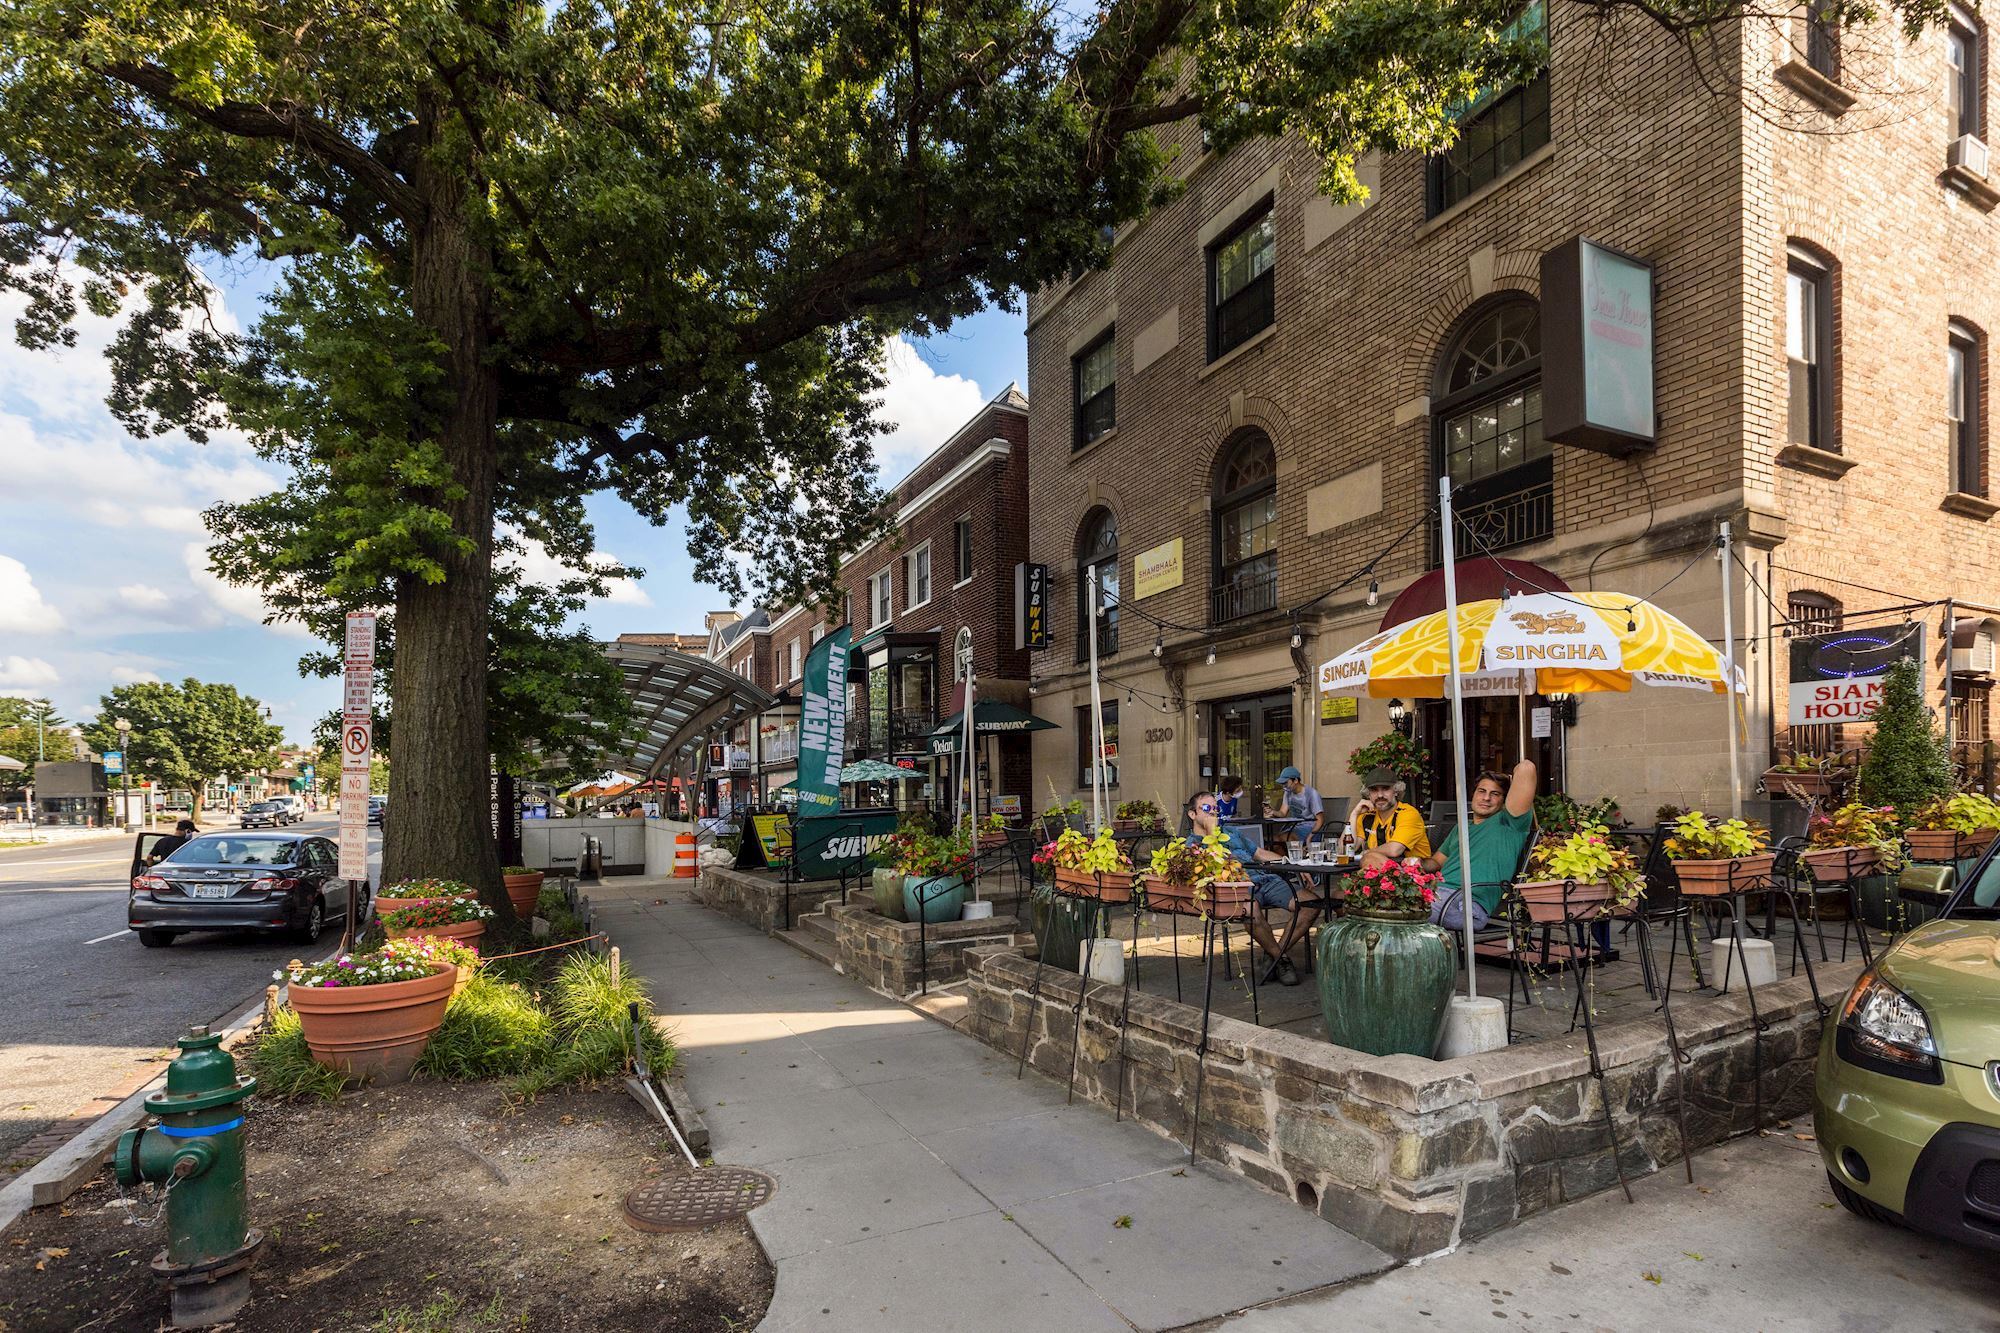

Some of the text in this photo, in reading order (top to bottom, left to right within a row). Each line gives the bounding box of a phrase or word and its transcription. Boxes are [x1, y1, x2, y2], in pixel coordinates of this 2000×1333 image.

[1138, 557, 1178, 578] SHAMBHALA
[1029, 568, 1043, 643] SUBWAY
[1496, 644, 1607, 660] SINGHA
[1322, 659, 1367, 683] SINGHA
[1815, 682, 1888, 701] SIAM
[824, 642, 847, 786] MANAGEMENT
[1805, 700, 1885, 719] HOUS
[801, 692, 828, 751] NEW
[975, 720, 1031, 730] SUBWAY
[1145, 727, 1173, 743] 3520
[897, 760, 914, 768] OPEN
[349, 780, 362, 789] NO
[490, 778, 498, 800] Park
[343, 792, 367, 800] PARKING
[798, 790, 837, 806] SUBWAY
[513, 802, 521, 839] Station
[349, 831, 358, 839] NO
